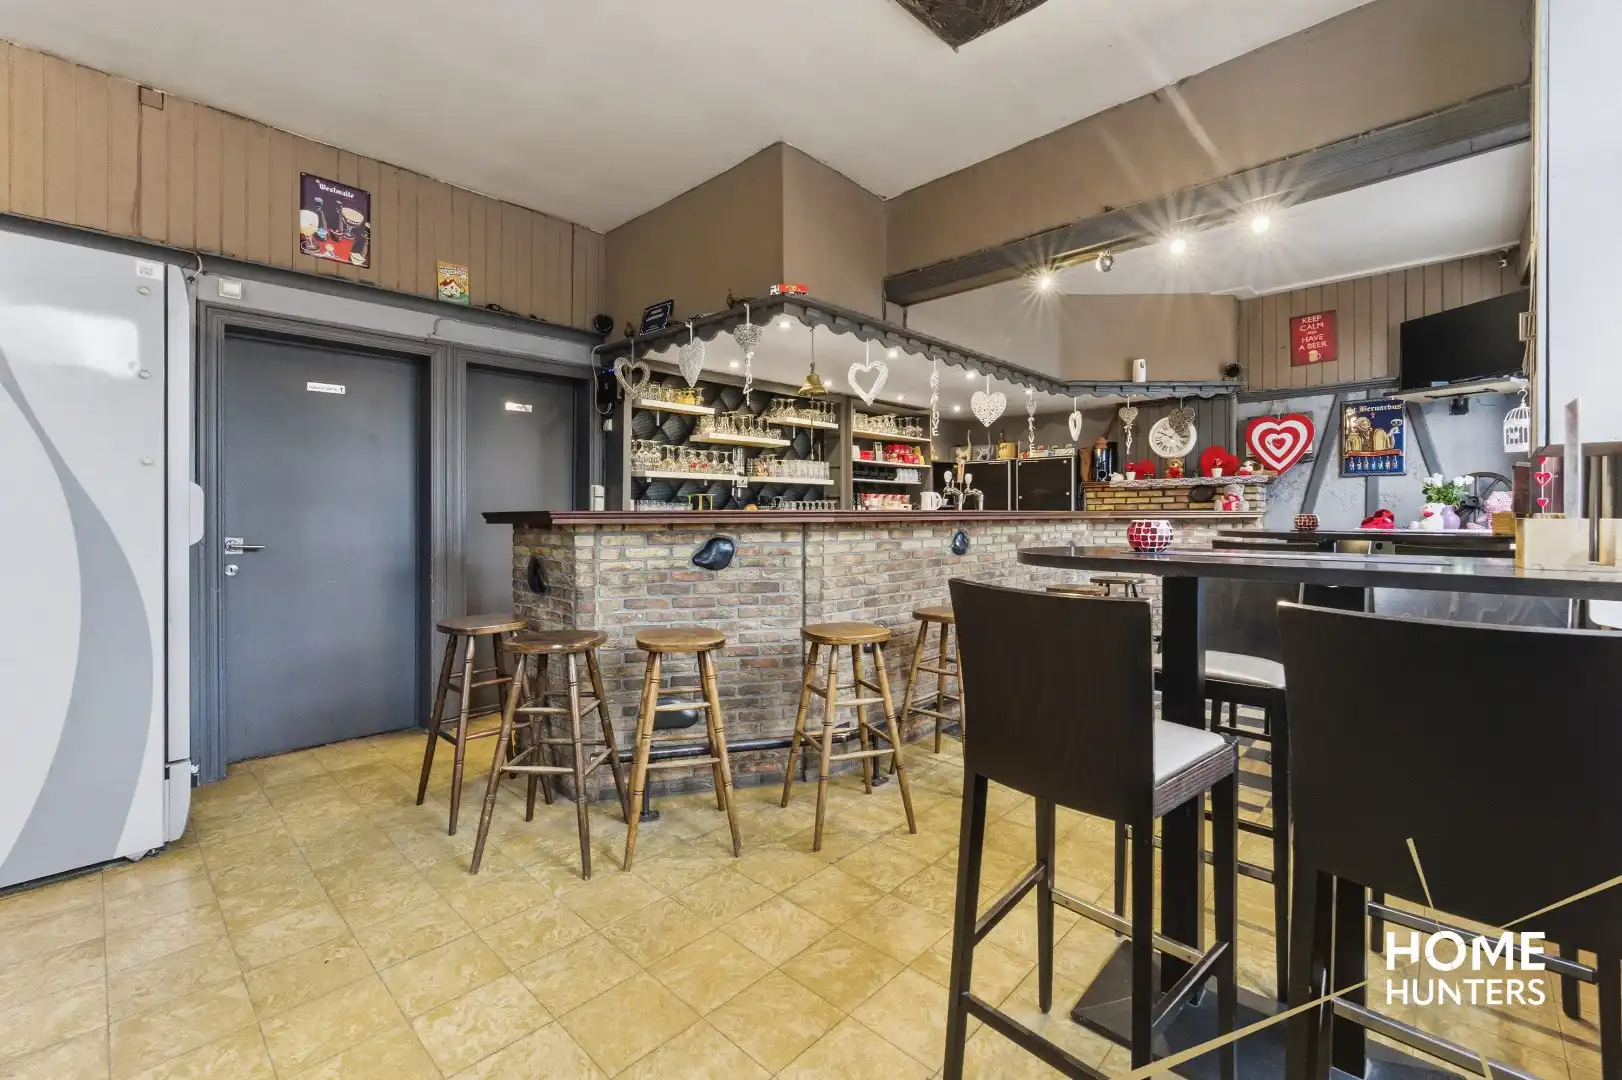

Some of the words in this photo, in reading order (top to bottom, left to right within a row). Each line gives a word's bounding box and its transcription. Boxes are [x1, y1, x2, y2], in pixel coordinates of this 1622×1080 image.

[319, 183, 355, 199] Westmalle
[1301, 314, 1322, 324] KEEP
[1299, 321, 1324, 332] CALM
[1301, 333, 1324, 344] HAVE
[1307, 340, 1328, 350] BEER
